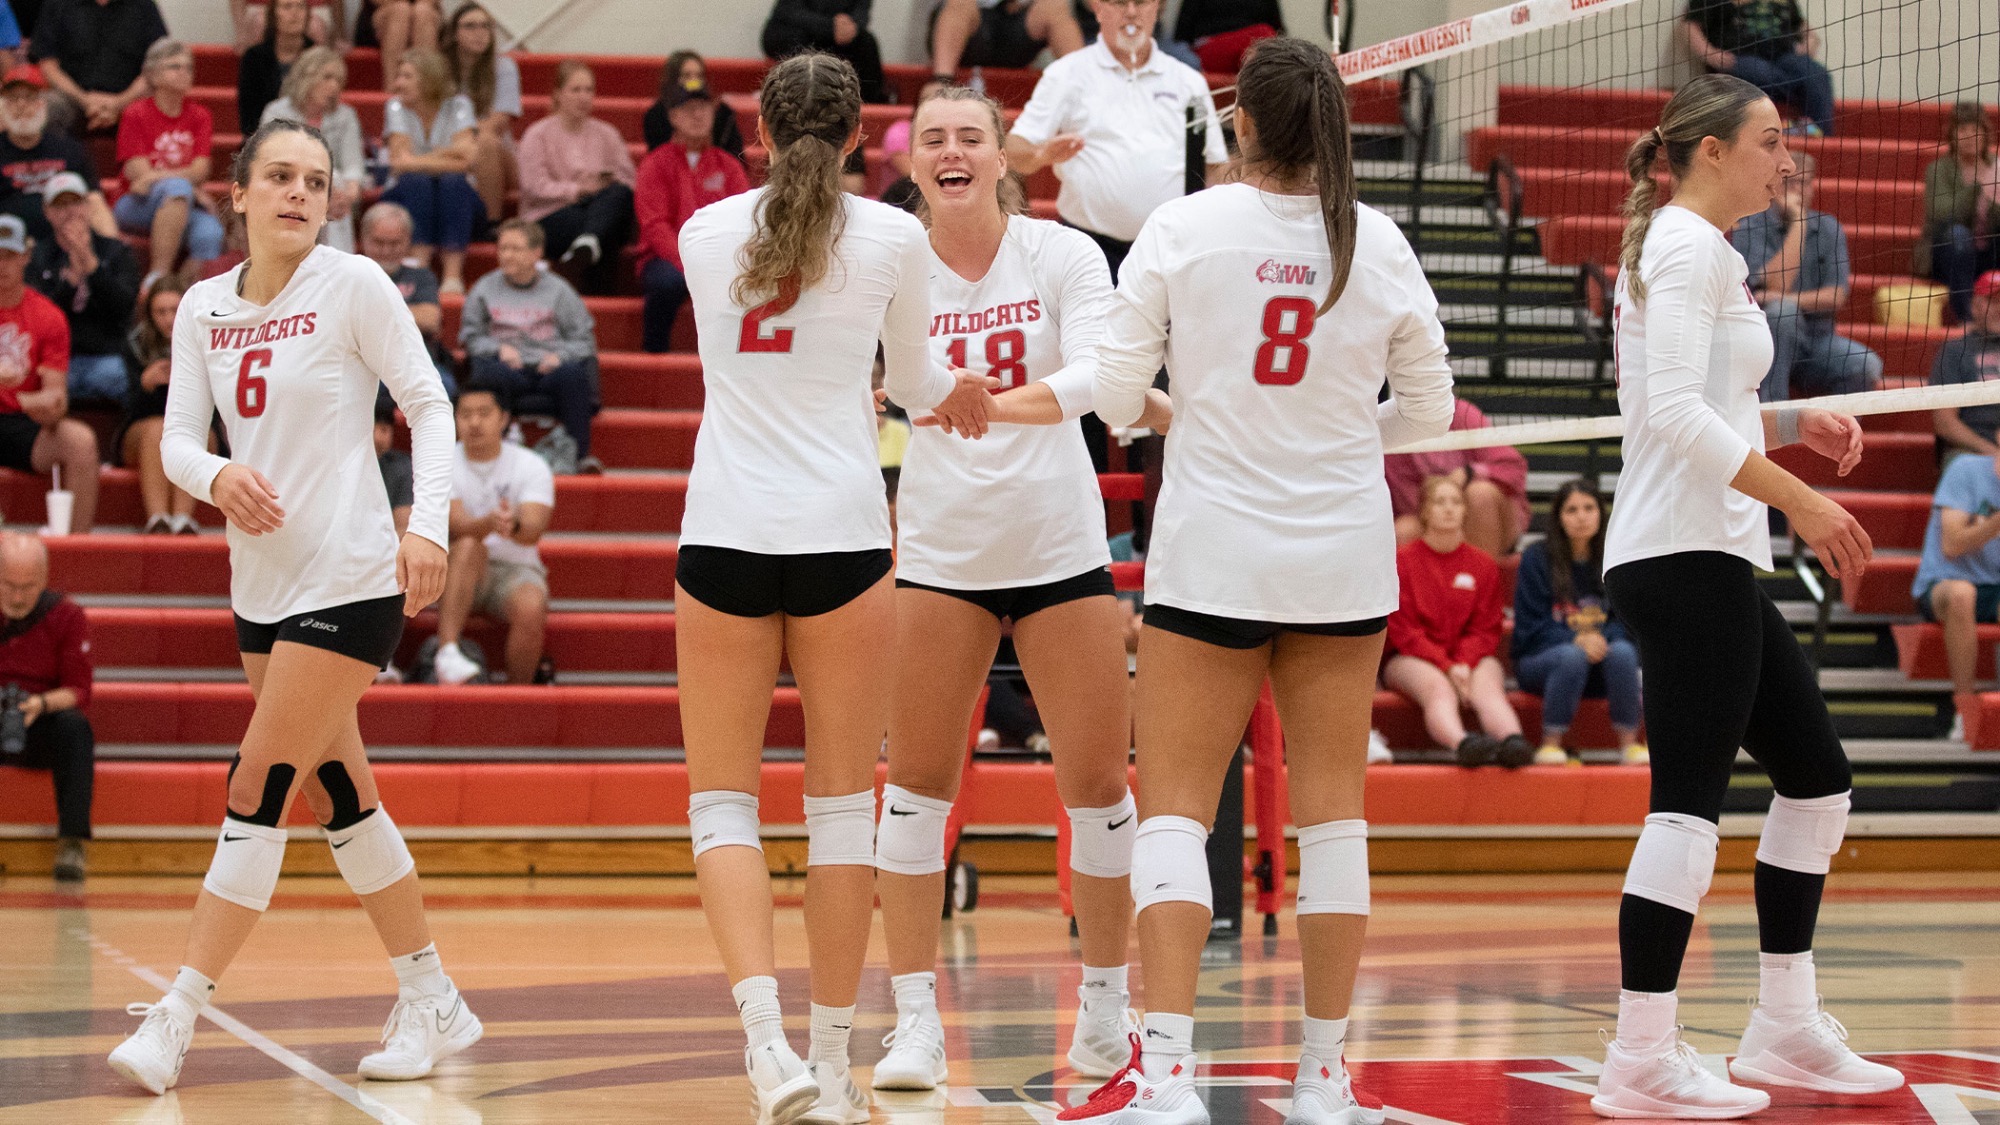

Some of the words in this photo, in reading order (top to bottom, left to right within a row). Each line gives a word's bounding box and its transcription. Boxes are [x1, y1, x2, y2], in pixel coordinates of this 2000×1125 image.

[1412, 17, 1473, 56] UNIVERSITY
[210, 312, 317, 350] WILDCATS
[736, 261, 803, 354] 2
[1252, 295, 1318, 387] 8
[235, 347, 273, 419] 6
[945, 327, 1028, 396] 18
